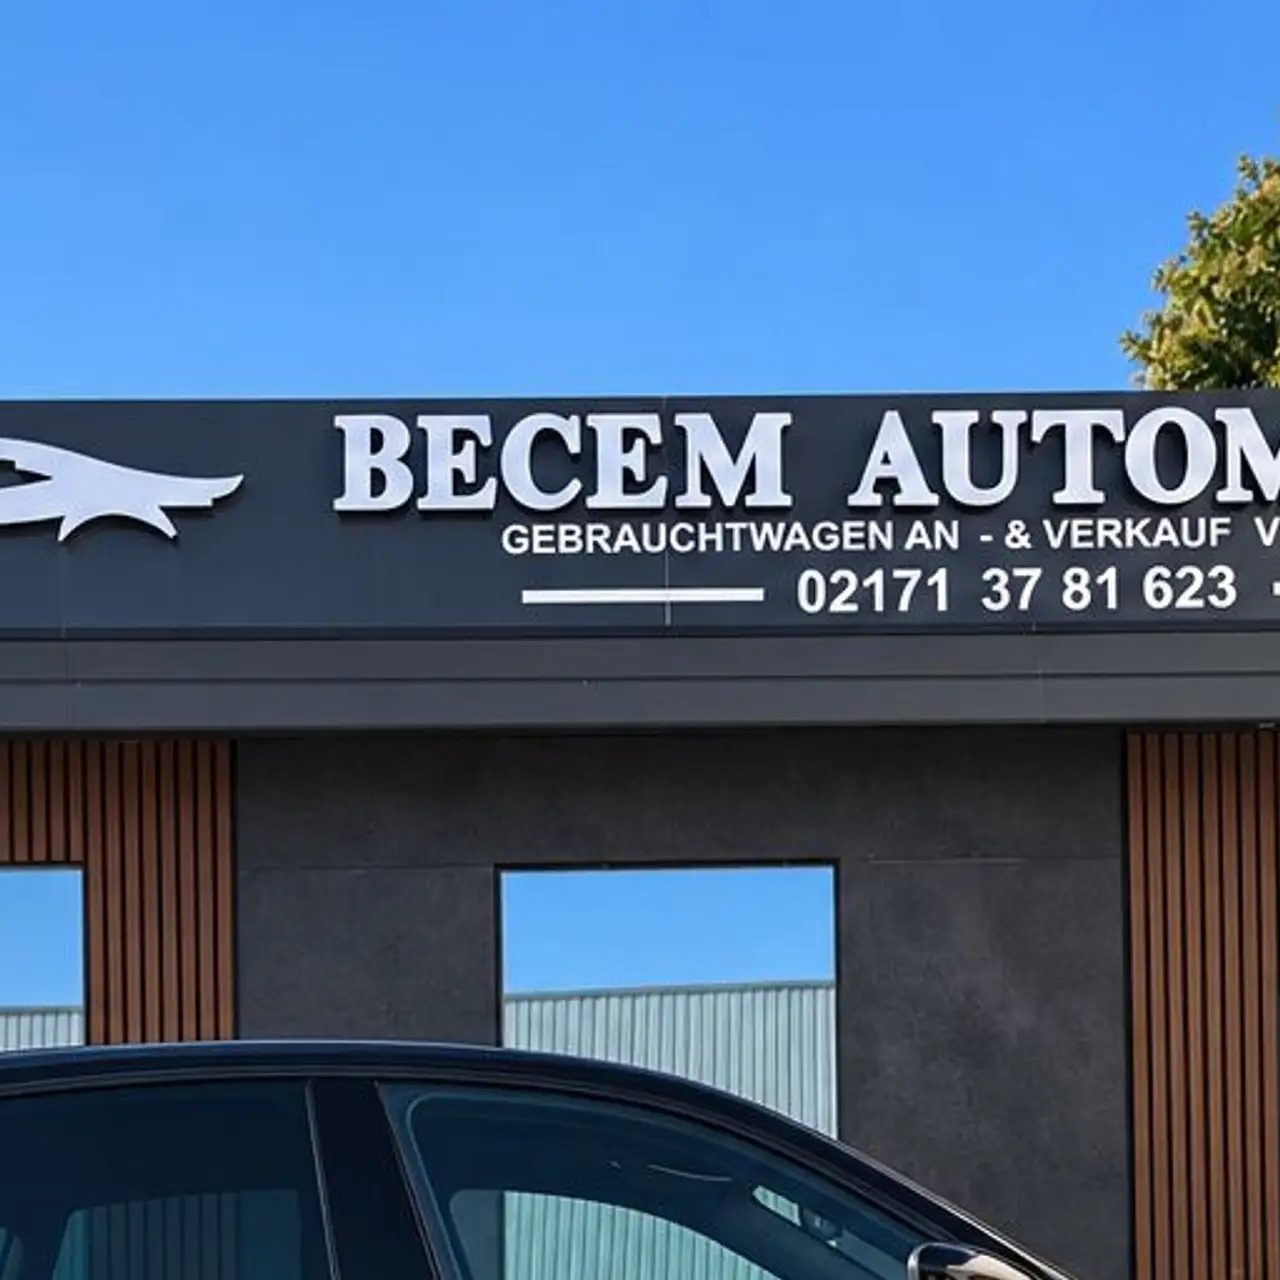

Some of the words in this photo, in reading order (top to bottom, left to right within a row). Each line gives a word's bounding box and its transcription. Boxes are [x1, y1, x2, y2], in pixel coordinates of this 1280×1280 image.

[333, 412, 793, 511] BECEM
[502, 520, 894, 555] GEBRAUCHTWAGEN
[904, 519, 960, 551] AN
[1004, 519, 1033, 550] &
[1042, 516, 1232, 550] VERKAUF
[797, 567, 950, 614] 02171
[982, 566, 1043, 612] 37
[1062, 565, 1118, 611] 81
[1142, 564, 1238, 610] 623
